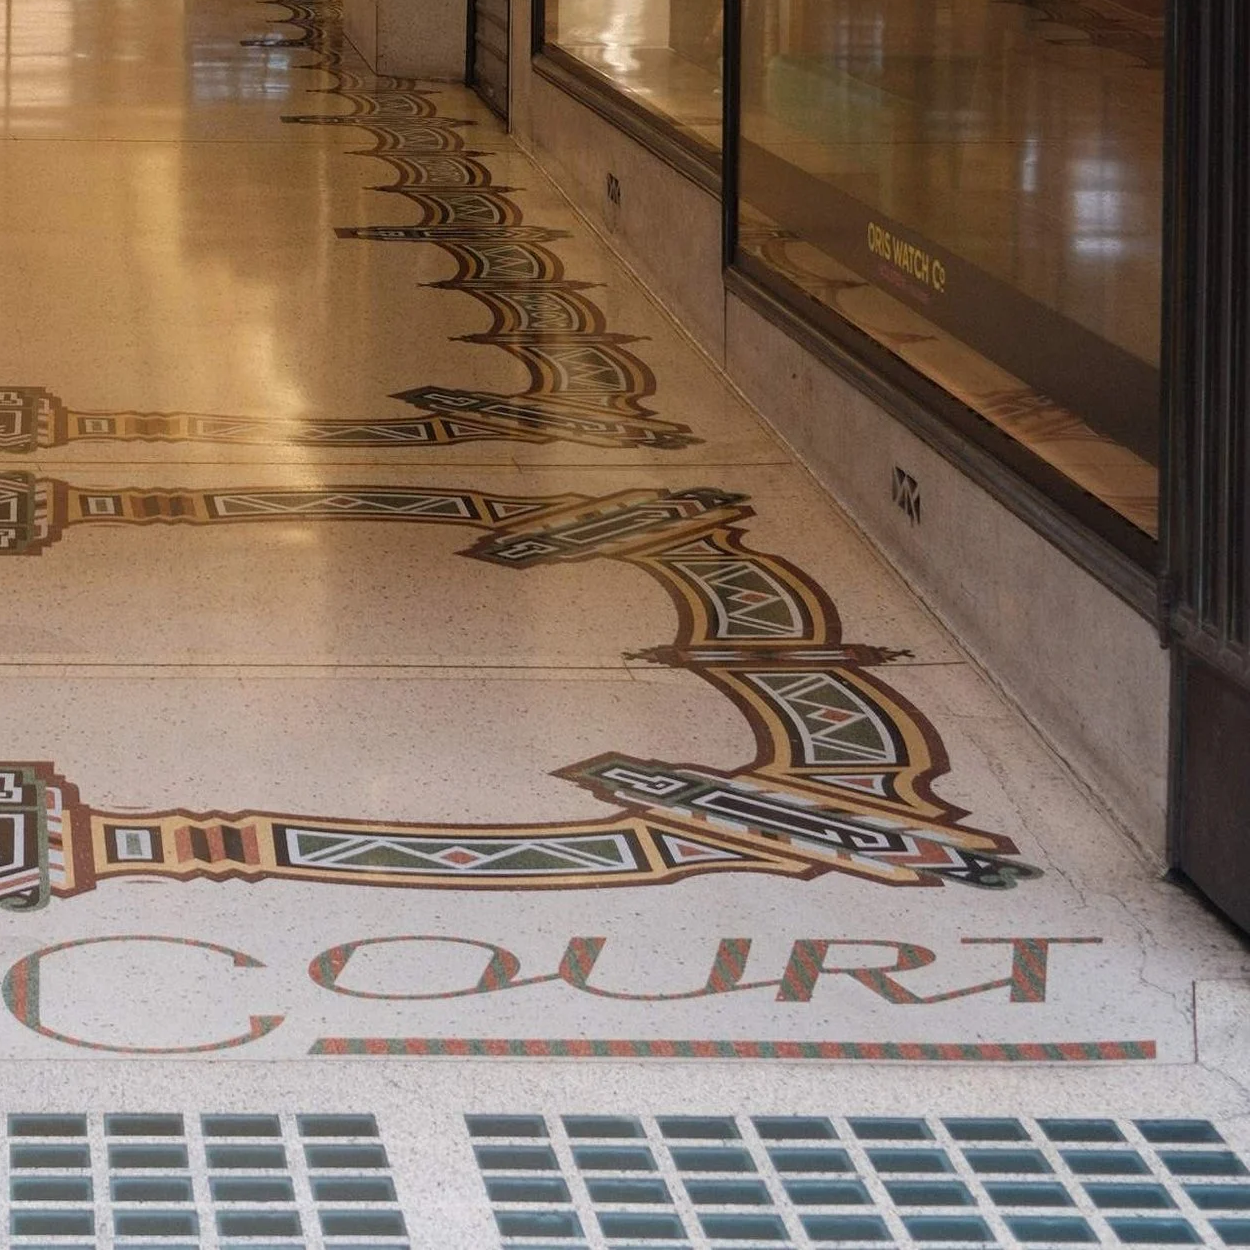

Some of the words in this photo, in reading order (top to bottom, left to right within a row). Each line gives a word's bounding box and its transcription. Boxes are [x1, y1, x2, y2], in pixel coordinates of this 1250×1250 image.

[867, 221, 892, 261] ORIS
[892, 235, 930, 286] WATCH
[0, 933, 1104, 1053] COURT
